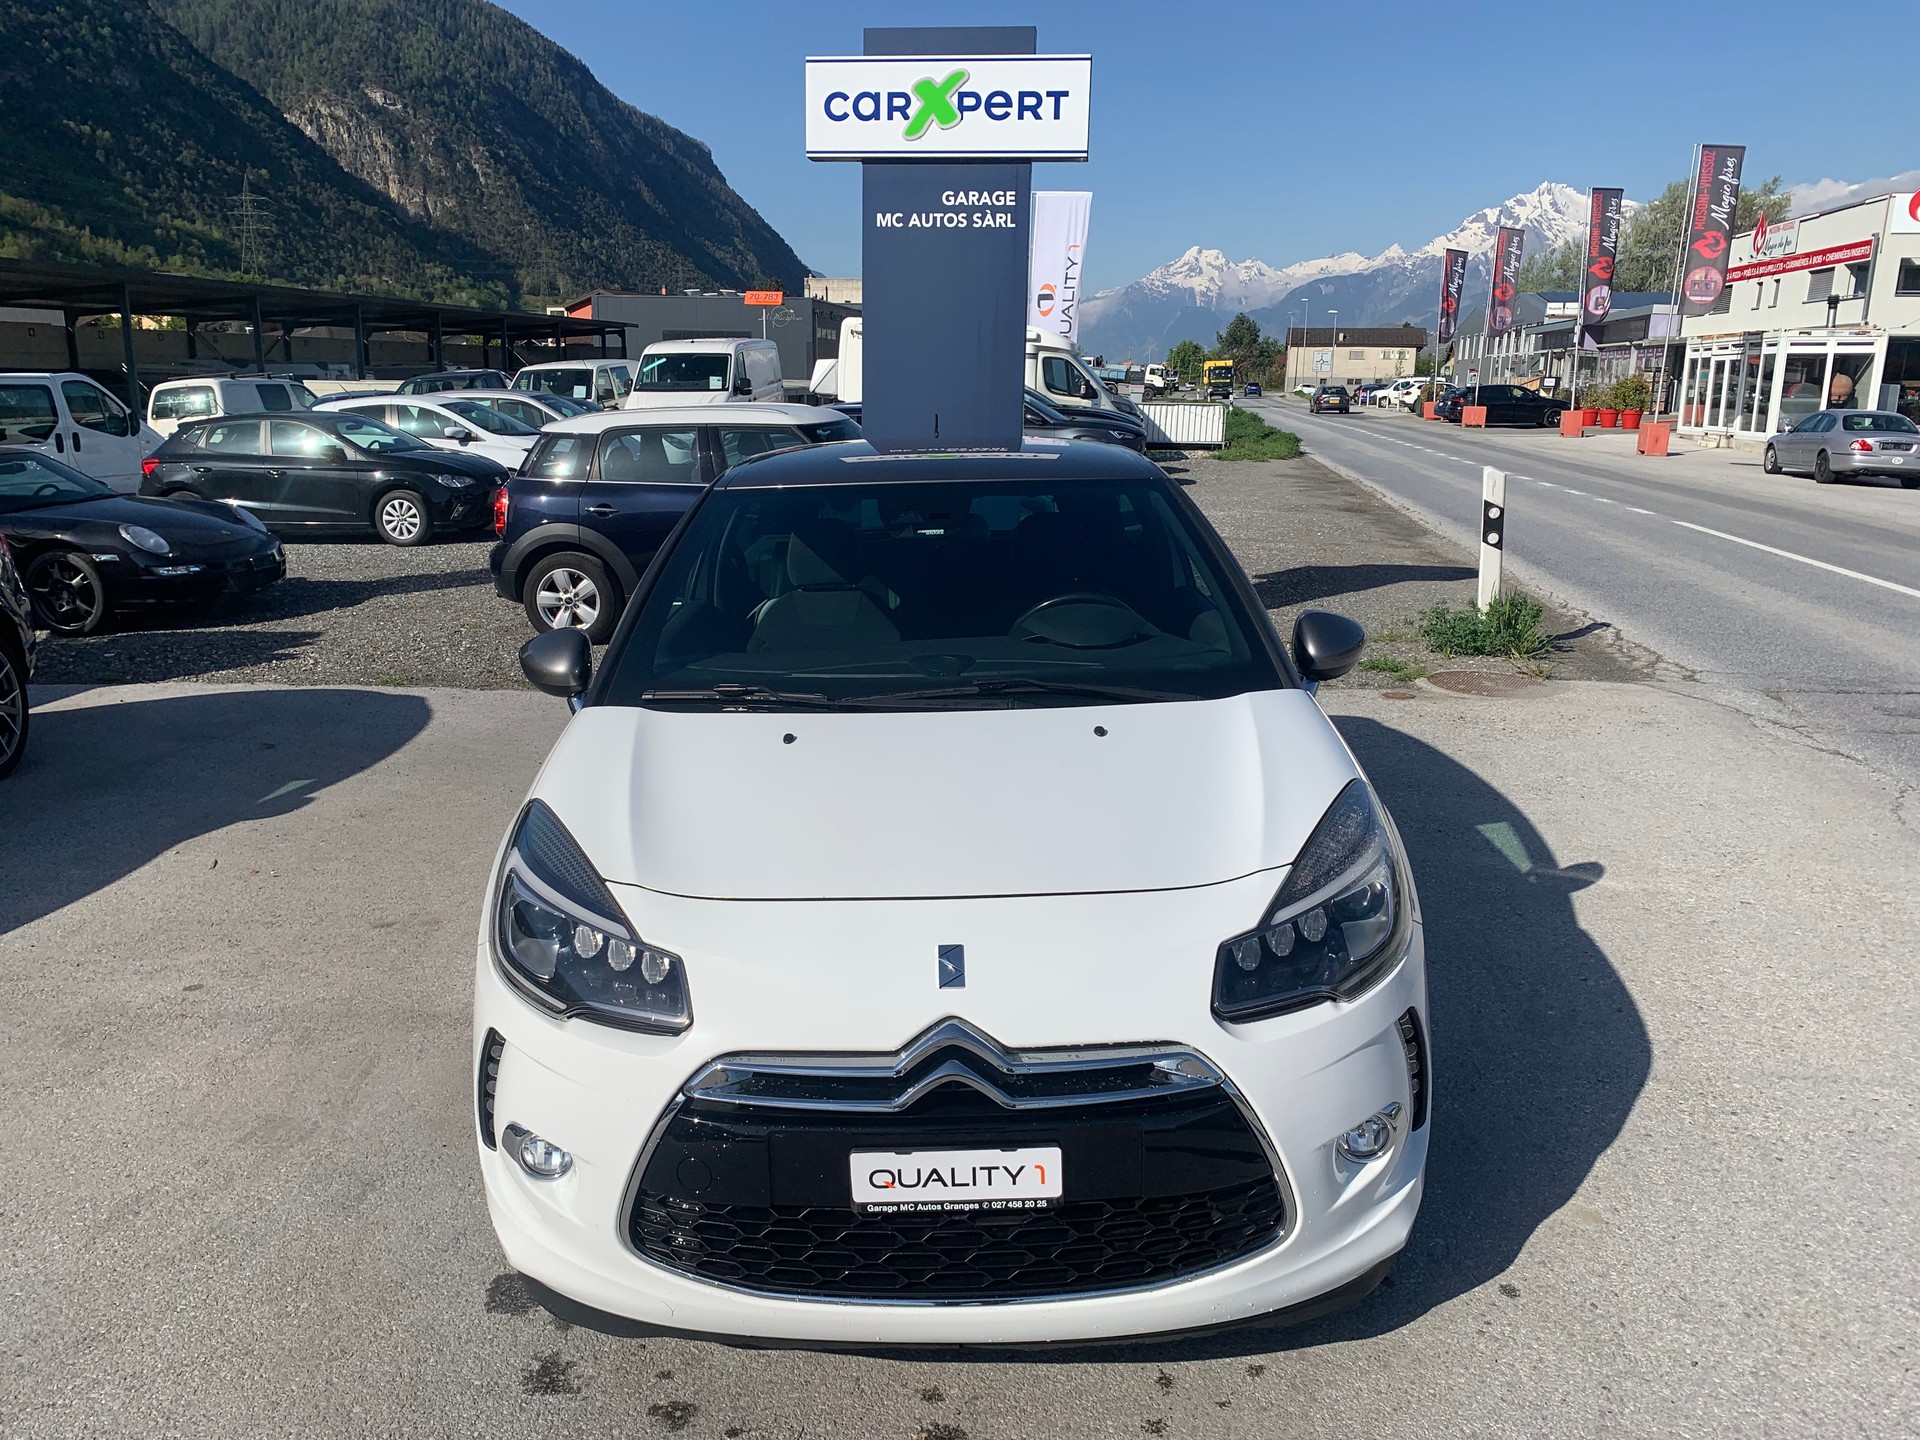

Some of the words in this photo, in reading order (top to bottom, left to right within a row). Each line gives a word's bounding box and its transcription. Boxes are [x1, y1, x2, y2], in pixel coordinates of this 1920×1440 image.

[1717, 156, 1740, 185] fires
[941, 190, 1016, 206] GARAGE
[1694, 150, 1716, 230] MOSONI-VUISSOZ
[876, 212, 904, 228] MC
[908, 212, 968, 228] AUTOS
[972, 209, 1016, 228] SÀRL
[1710, 183, 1738, 230] Magic
[749, 293, 779, 301] 70-783
[1059, 256, 1078, 339] UALITY
[868, 1164, 1026, 1189] QUALITY
[1033, 1164, 1046, 1185] 1
[867, 1204, 898, 1214] Garage
[900, 1203, 915, 1211] MC
[916, 1203, 942, 1211] Autos
[943, 1202, 979, 1212] Granges
[991, 1201, 1005, 1209] 027
[1007, 1200, 1022, 1209] 458
[1024, 1200, 1035, 1208] 20
[1036, 1199, 1047, 1208] 25
